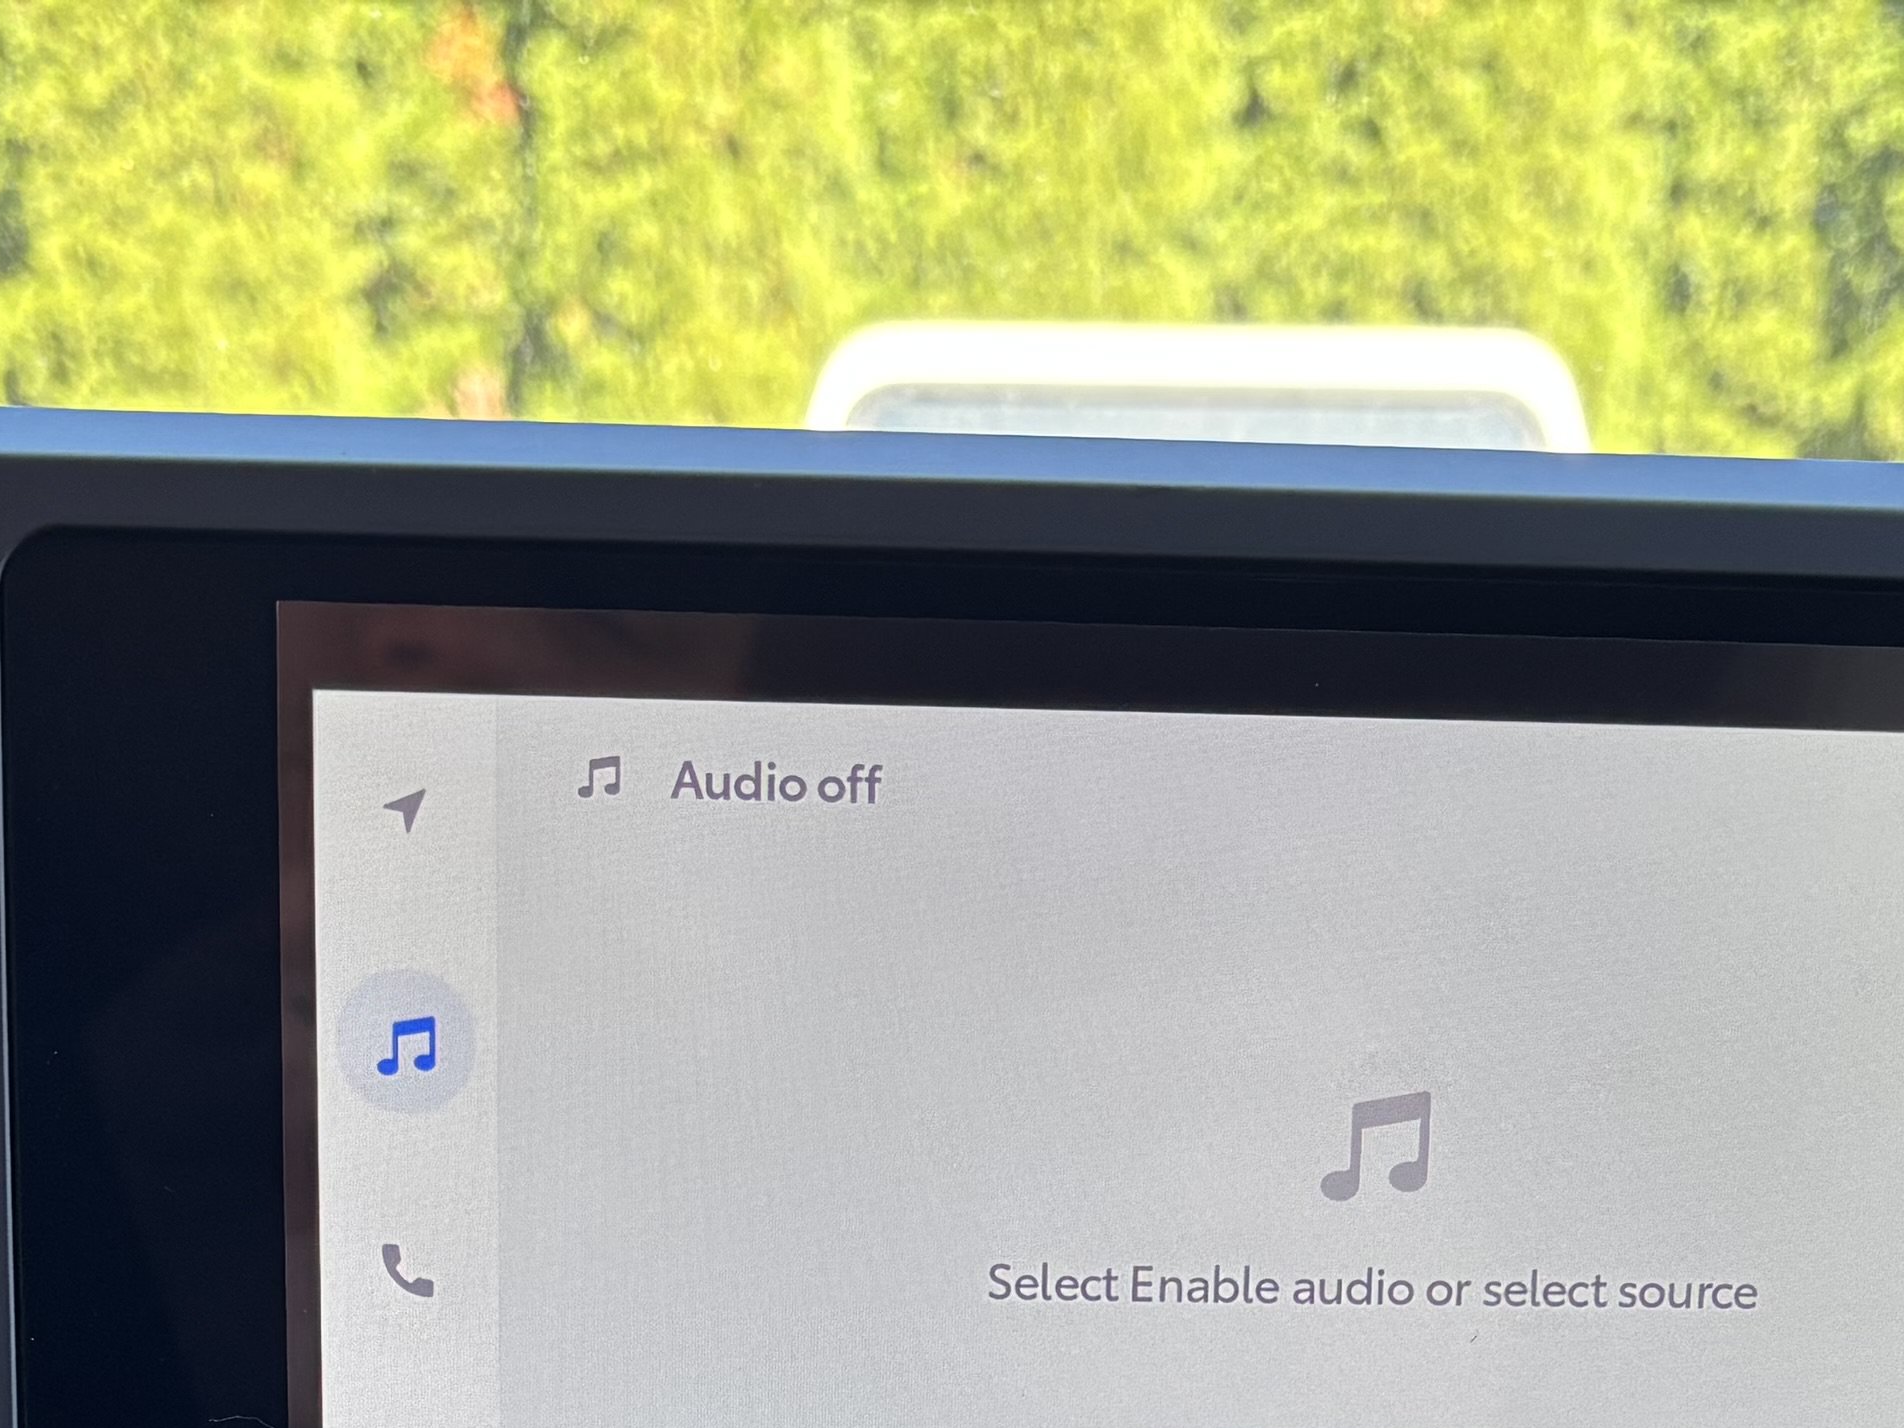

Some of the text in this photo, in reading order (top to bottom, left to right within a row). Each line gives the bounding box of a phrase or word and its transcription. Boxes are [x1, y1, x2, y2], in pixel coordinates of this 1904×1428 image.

[670, 760, 884, 804] Audio off
[987, 1263, 1759, 1311] Select Enable audio or select source
